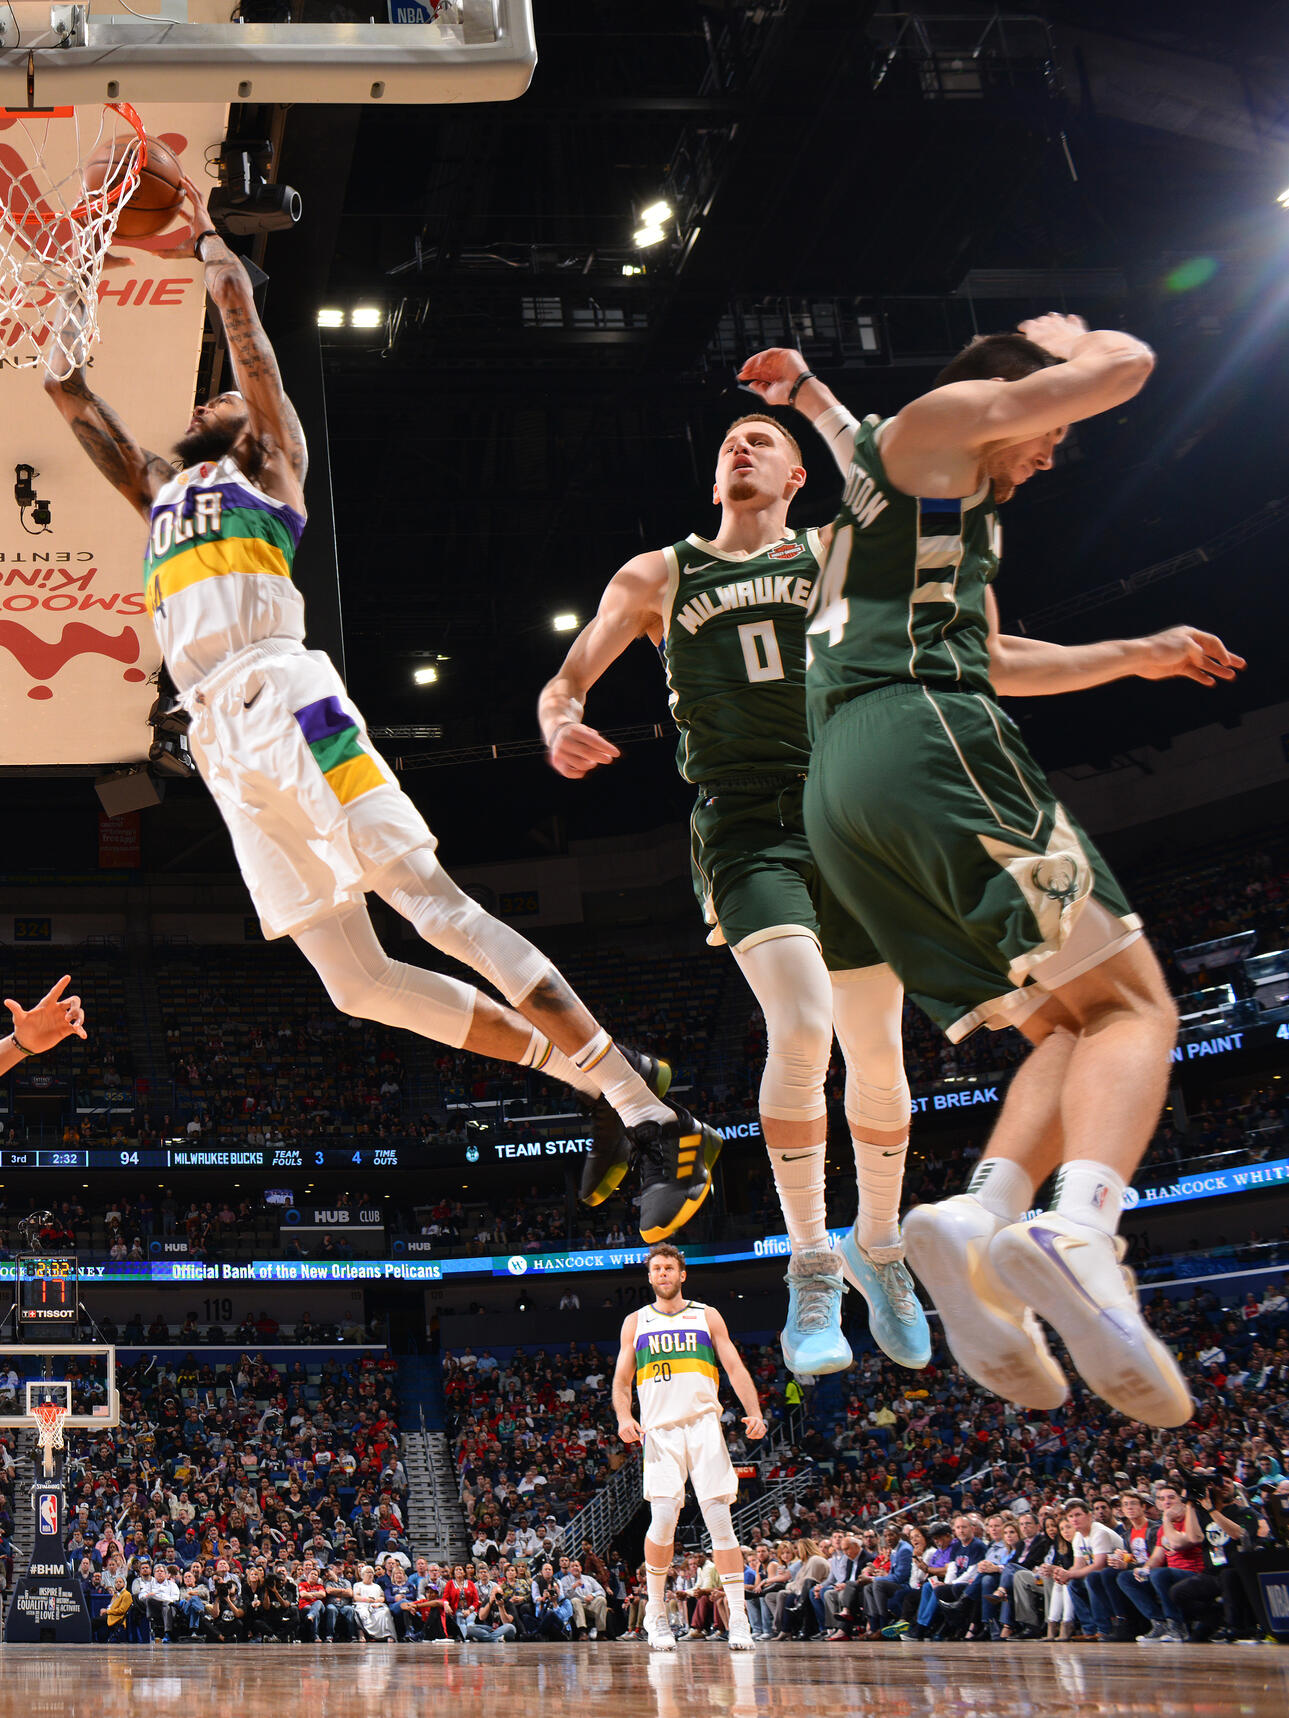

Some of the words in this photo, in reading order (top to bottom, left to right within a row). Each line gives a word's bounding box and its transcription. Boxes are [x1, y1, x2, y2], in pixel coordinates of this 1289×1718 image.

[397, 7, 425, 24] NBA
[149, 491, 223, 565] OLA
[677, 575, 813, 635] MILWAUKE
[737, 619, 785, 683] 0
[15, 919, 50, 938] 324
[1187, 1032, 1245, 1060] PAINT
[909, 1097, 928, 1113] ST
[933, 1086, 999, 1111] BREAK
[717, 1121, 760, 1141] ANCE
[11, 1153, 27, 1163] 3rd
[52, 1152, 78, 1164] 2:32
[119, 1150, 139, 1166] 94
[174, 1152, 229, 1165] MILWAUKEE
[230, 1152, 264, 1165] BUCKS
[273, 1151, 300, 1160] TEAM
[315, 1152, 324, 1165] 3
[351, 1152, 362, 1165] 4
[373, 1150, 397, 1159] TIME
[494, 1143, 542, 1159] TEAM
[272, 1157, 303, 1166] FOULS
[373, 1157, 398, 1166] OUTS
[1144, 1177, 1228, 1201] HANCOCK
[313, 1210, 350, 1223] HUB
[359, 1210, 380, 1223] CLUB
[163, 1242, 188, 1253] HUB
[407, 1241, 432, 1252] HUB
[753, 1238, 791, 1257] Offici
[37, 1262, 70, 1277] 2:32
[533, 1255, 605, 1270] HANCOCK
[172, 1262, 220, 1280] Official
[222, 1263, 254, 1280] Bank
[256, 1262, 274, 1280] of
[276, 1262, 298, 1280] the
[300, 1263, 329, 1280] New
[331, 1262, 381, 1280] Orleans
[384, 1262, 441, 1280] Pelicans
[42, 1278, 65, 1303] 17
[36, 1310, 75, 1318] TISSOT
[203, 1298, 233, 1321] 119
[648, 1331, 697, 1356] NOLA
[652, 1362, 672, 1383] 20
[30, 1563, 65, 1575] #BHM
[38, 1587, 58, 1597] INSPIRE
[17, 1599, 49, 1610] EQUALITY
[40, 1610, 55, 1620] LOVE
